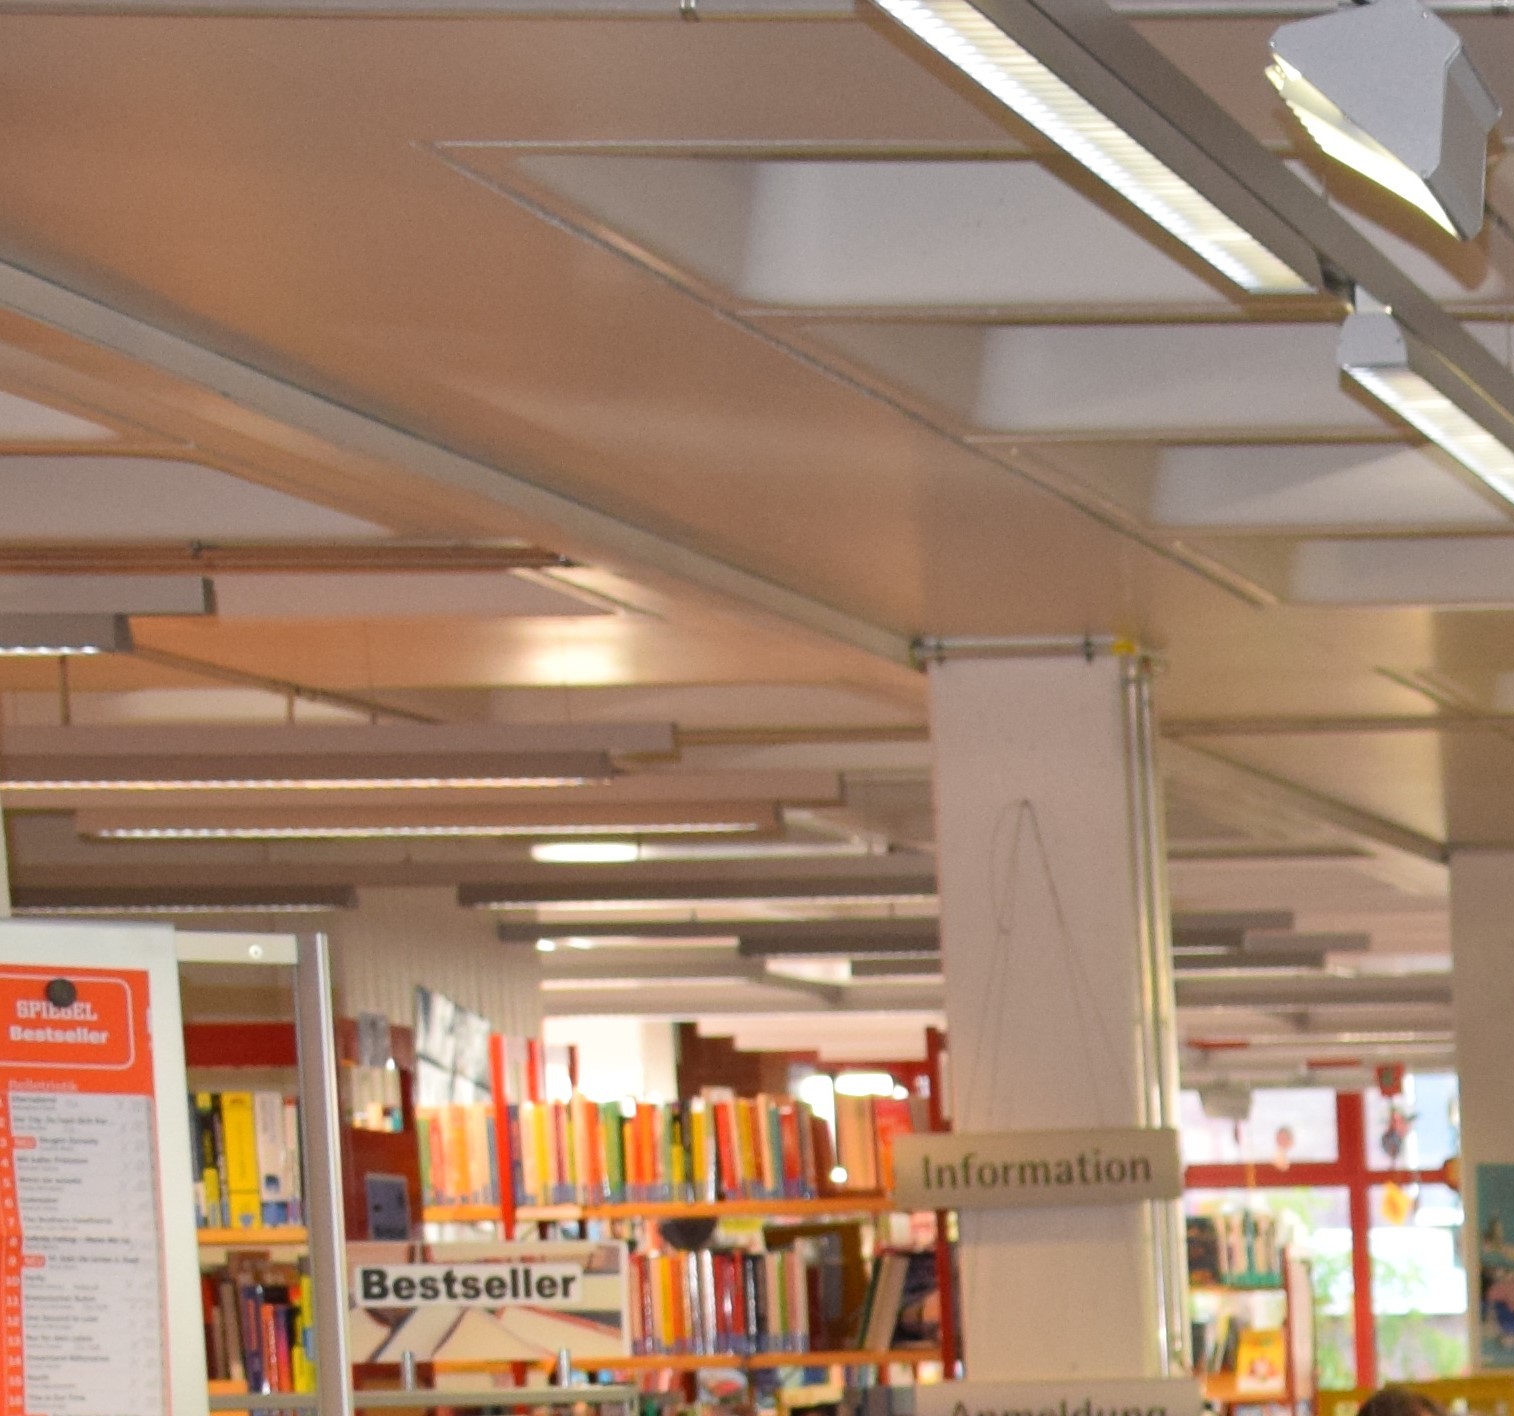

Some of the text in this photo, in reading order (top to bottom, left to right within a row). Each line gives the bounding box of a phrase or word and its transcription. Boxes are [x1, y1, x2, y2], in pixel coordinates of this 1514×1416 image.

[9, 1025, 109, 1045] Bestseller
[921, 1149, 1152, 1190] Information
[361, 1267, 577, 1300] Bestseller
